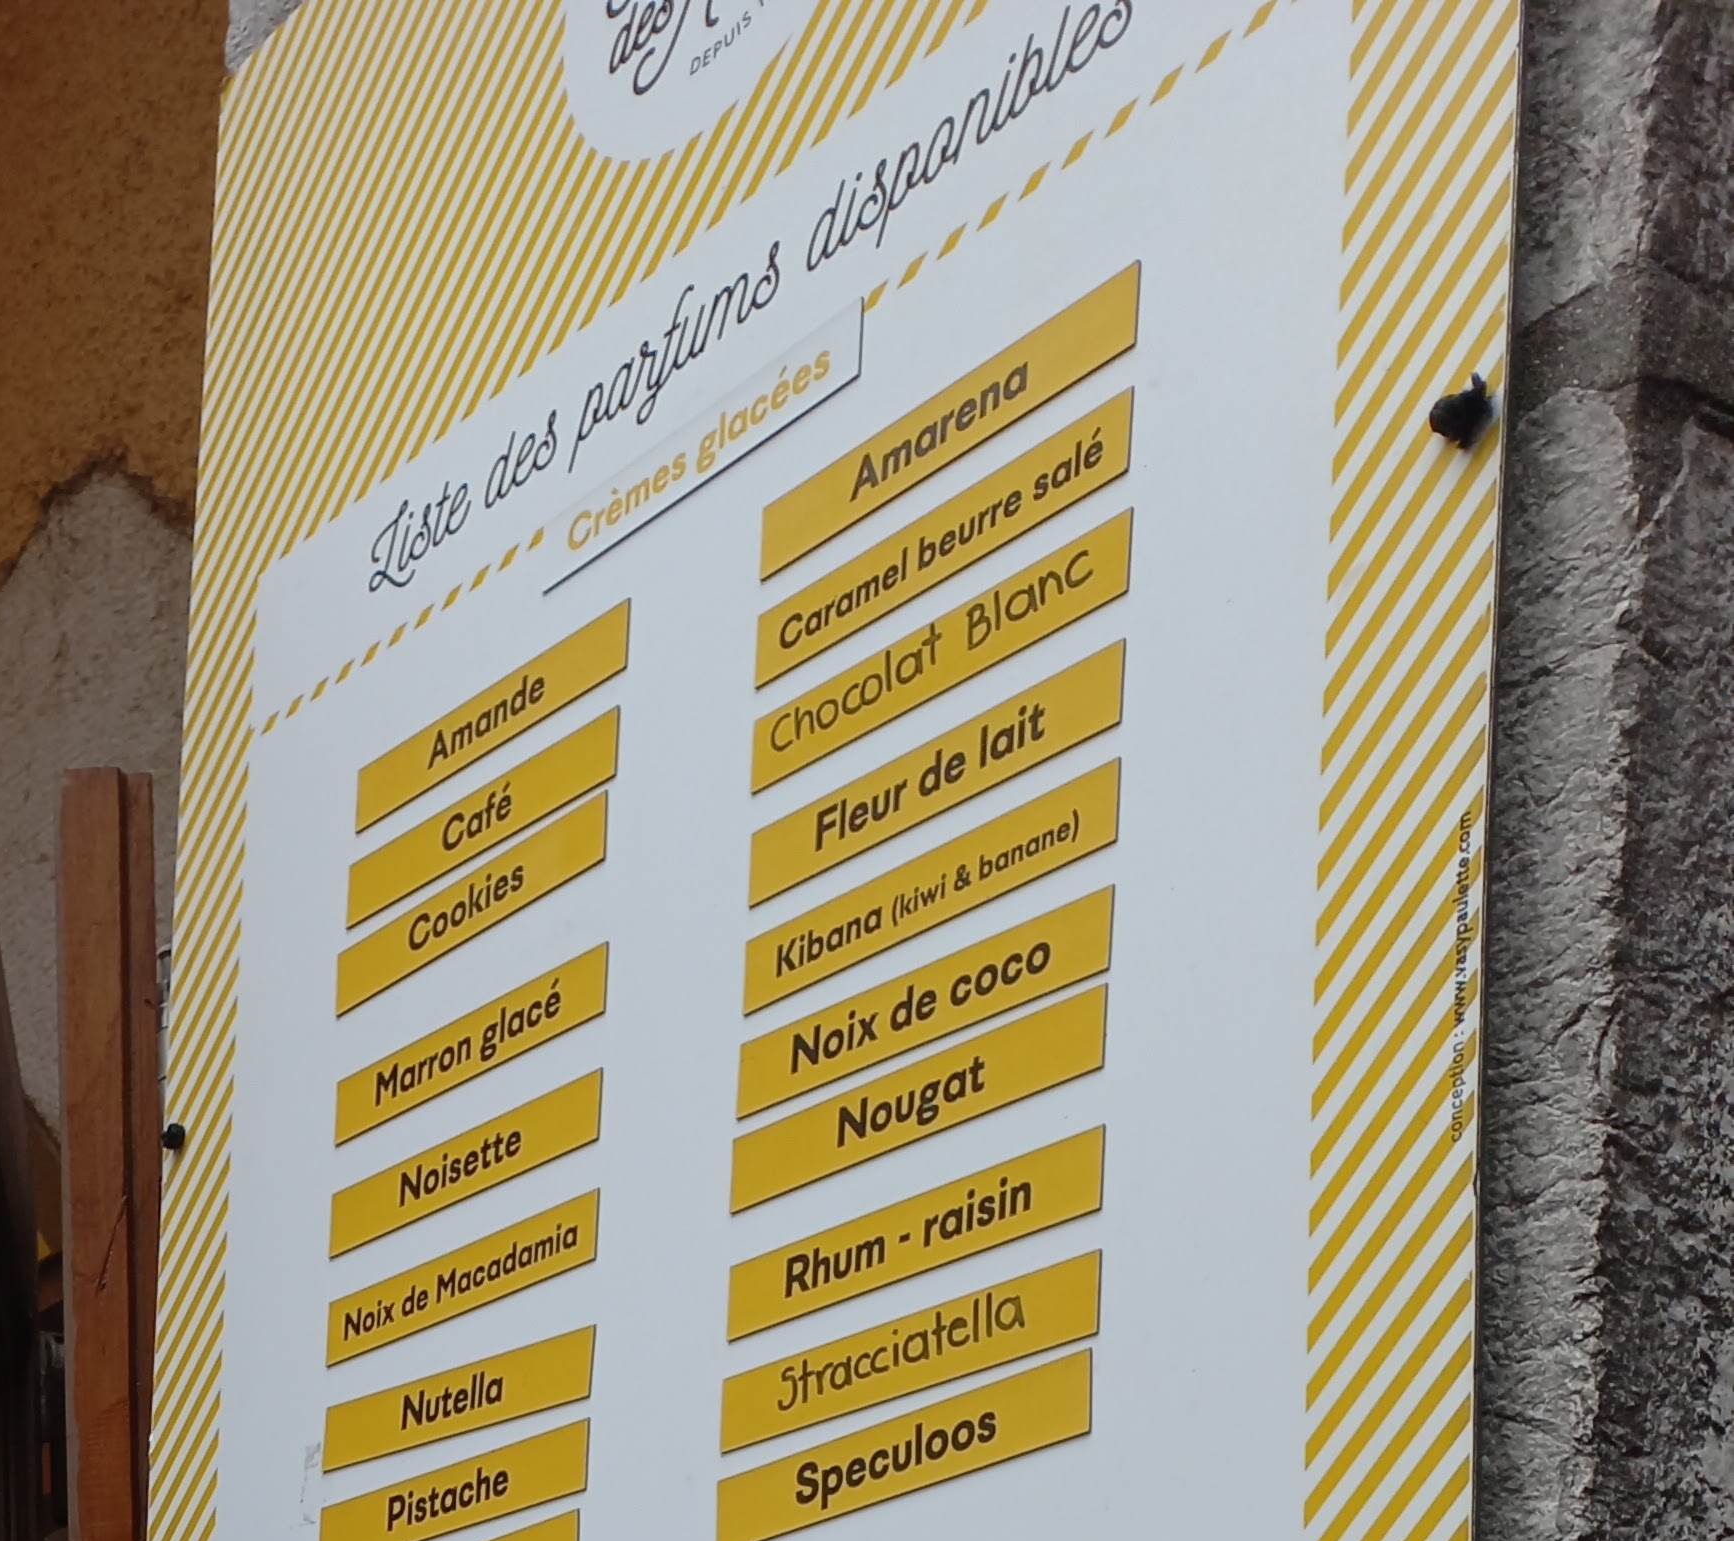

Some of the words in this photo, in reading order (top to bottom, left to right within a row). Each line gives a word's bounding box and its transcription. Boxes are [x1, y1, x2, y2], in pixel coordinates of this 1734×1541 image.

[690, 11, 752, 76] DEPUIS
[369, 473, 471, 592] Liste
[485, 412, 559, 506] des
[569, 242, 781, 473] parfums
[805, 0, 1134, 272] disponibles
[568, 455, 688, 552] Crèmes
[696, 346, 831, 483] glacées
[849, 360, 1029, 503] Amarena
[778, 546, 909, 650] Caramel
[916, 489, 1023, 573] beurre
[1032, 427, 1104, 501] salé
[427, 674, 546, 770] Amande
[769, 622, 943, 754] Chocolat
[442, 781, 513, 851] Café
[813, 778, 909, 853] Fleur
[917, 748, 966, 798] de
[978, 702, 1047, 770] lait
[408, 864, 524, 951] Cookies
[775, 904, 883, 979] Kibana
[891, 873, 947, 928] (kiwi
[953, 864, 972, 892] &
[978, 809, 1080, 881] banane)
[374, 1035, 472, 1106] Marron
[479, 977, 562, 1062] glacé
[789, 1010, 879, 1075] Noix
[889, 985, 937, 1031] de
[949, 941, 1051, 1006] coco
[836, 1056, 986, 1149] Nougat
[1450, 1041, 1466, 1144] conception
[398, 1129, 522, 1208] Noisette
[343, 1298, 395, 1341] Noix
[401, 1285, 429, 1318] de
[436, 1222, 579, 1304] Macadamia
[784, 1234, 886, 1300] Rhum
[898, 1233, 912, 1244] -
[923, 1176, 1032, 1249] raisin
[400, 1371, 504, 1431] Nutella
[777, 1292, 1026, 1412] Stracciatella
[386, 1466, 509, 1532] Pistache
[795, 1410, 997, 1510] Speculoos
